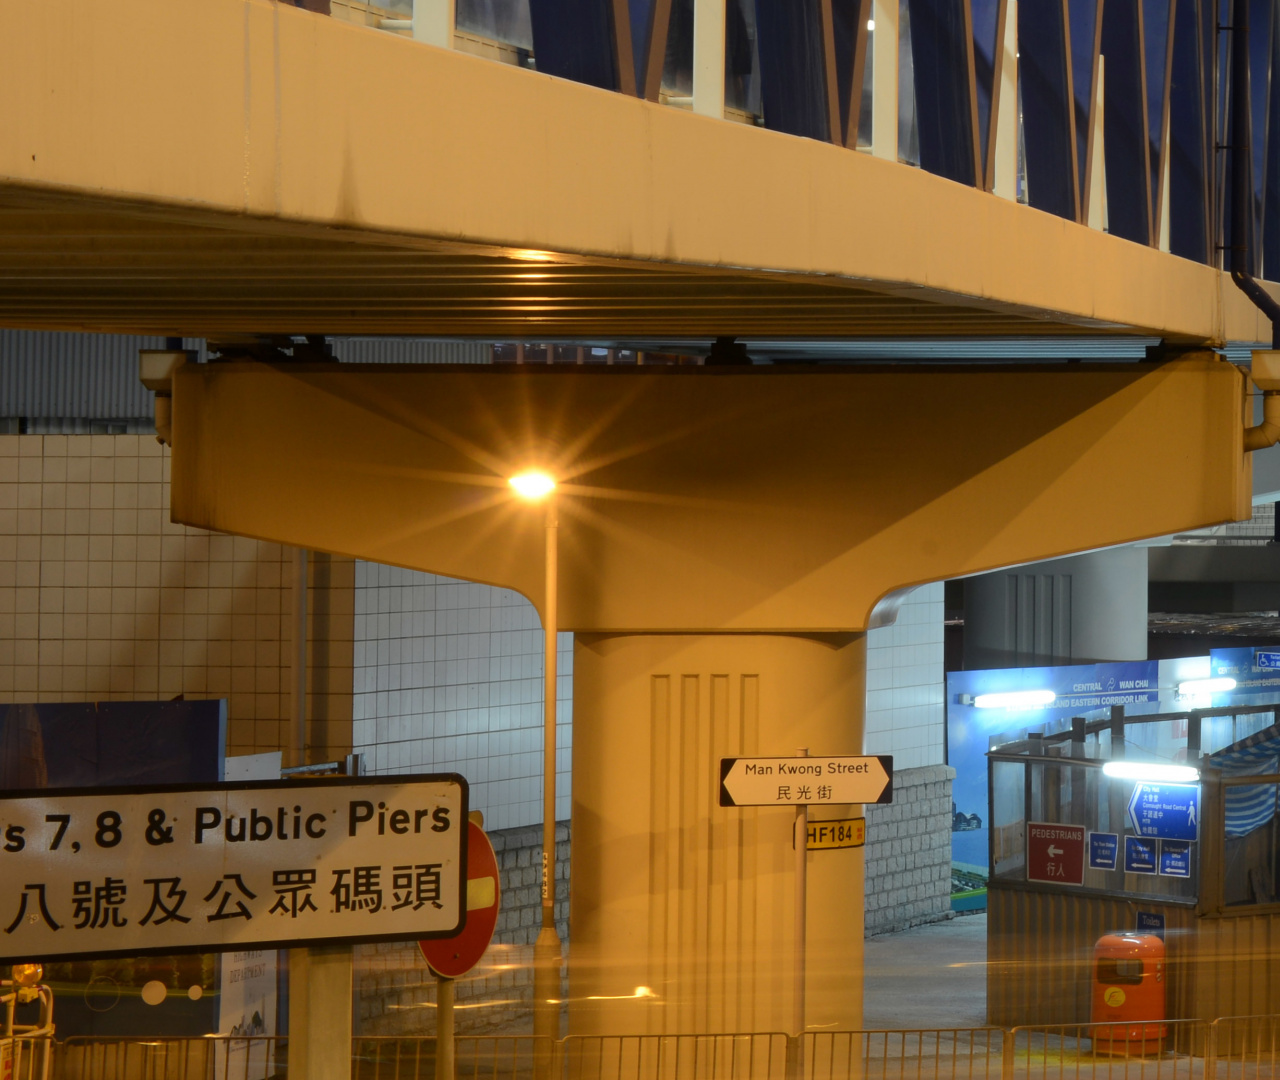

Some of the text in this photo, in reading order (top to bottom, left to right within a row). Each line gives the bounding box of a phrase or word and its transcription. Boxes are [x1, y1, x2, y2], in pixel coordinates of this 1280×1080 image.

[1218, 666, 1239, 674] CENTRAL
[1073, 680, 1148, 692] CENTRAL WAN CHAI
[1071, 697, 1100, 707] EASTERN
[1101, 695, 1134, 706] CORRIDOR
[1135, 694, 1148, 703] LINK
[745, 762, 869, 776] Man Kwong Street
[776, 785, 832, 801] 民光街
[0, 823, 26, 852] s
[145, 808, 175, 846] &
[194, 805, 327, 845] Public
[348, 799, 451, 837] Piers
[807, 826, 852, 843] HF184
[1031, 828, 1082, 841] PEDESTRIANS
[1046, 862, 1065, 877] 行人
[4, 863, 444, 935] 八號及公眾碼頭
[1142, 915, 1160, 927] Toilets
[229, 962, 267, 984] DEPARTMENT
